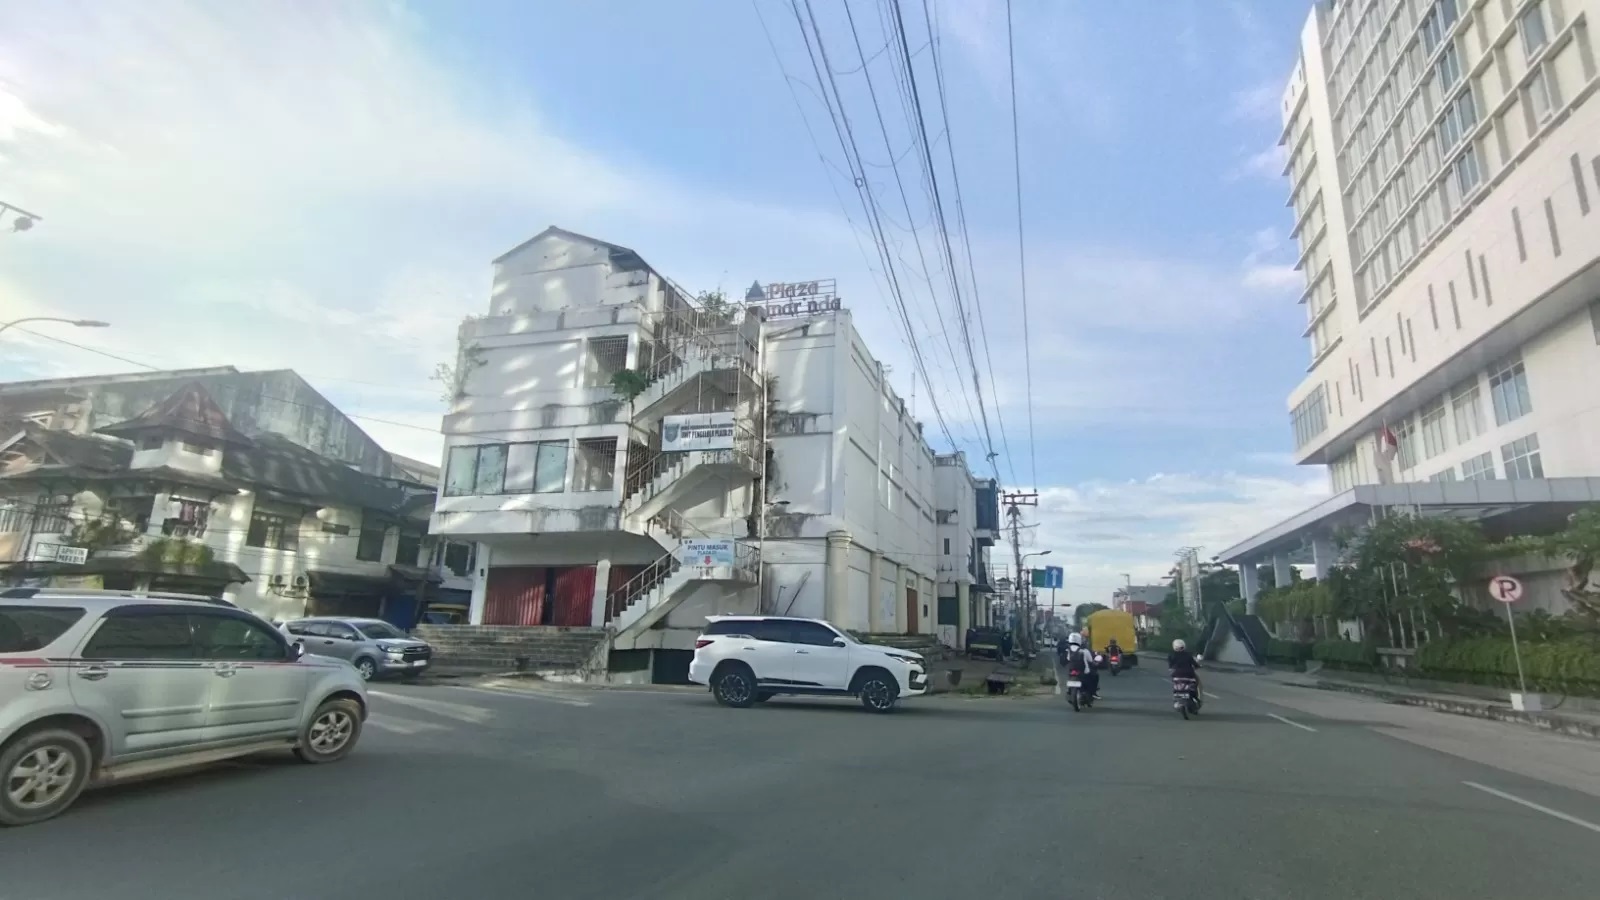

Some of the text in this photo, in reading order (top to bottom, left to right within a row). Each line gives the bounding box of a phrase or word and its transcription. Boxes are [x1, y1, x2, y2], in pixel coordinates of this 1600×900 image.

[769, 282, 819, 299] Plaza
[768, 295, 841, 316] marnda
[1498, 579, 1517, 599] P
